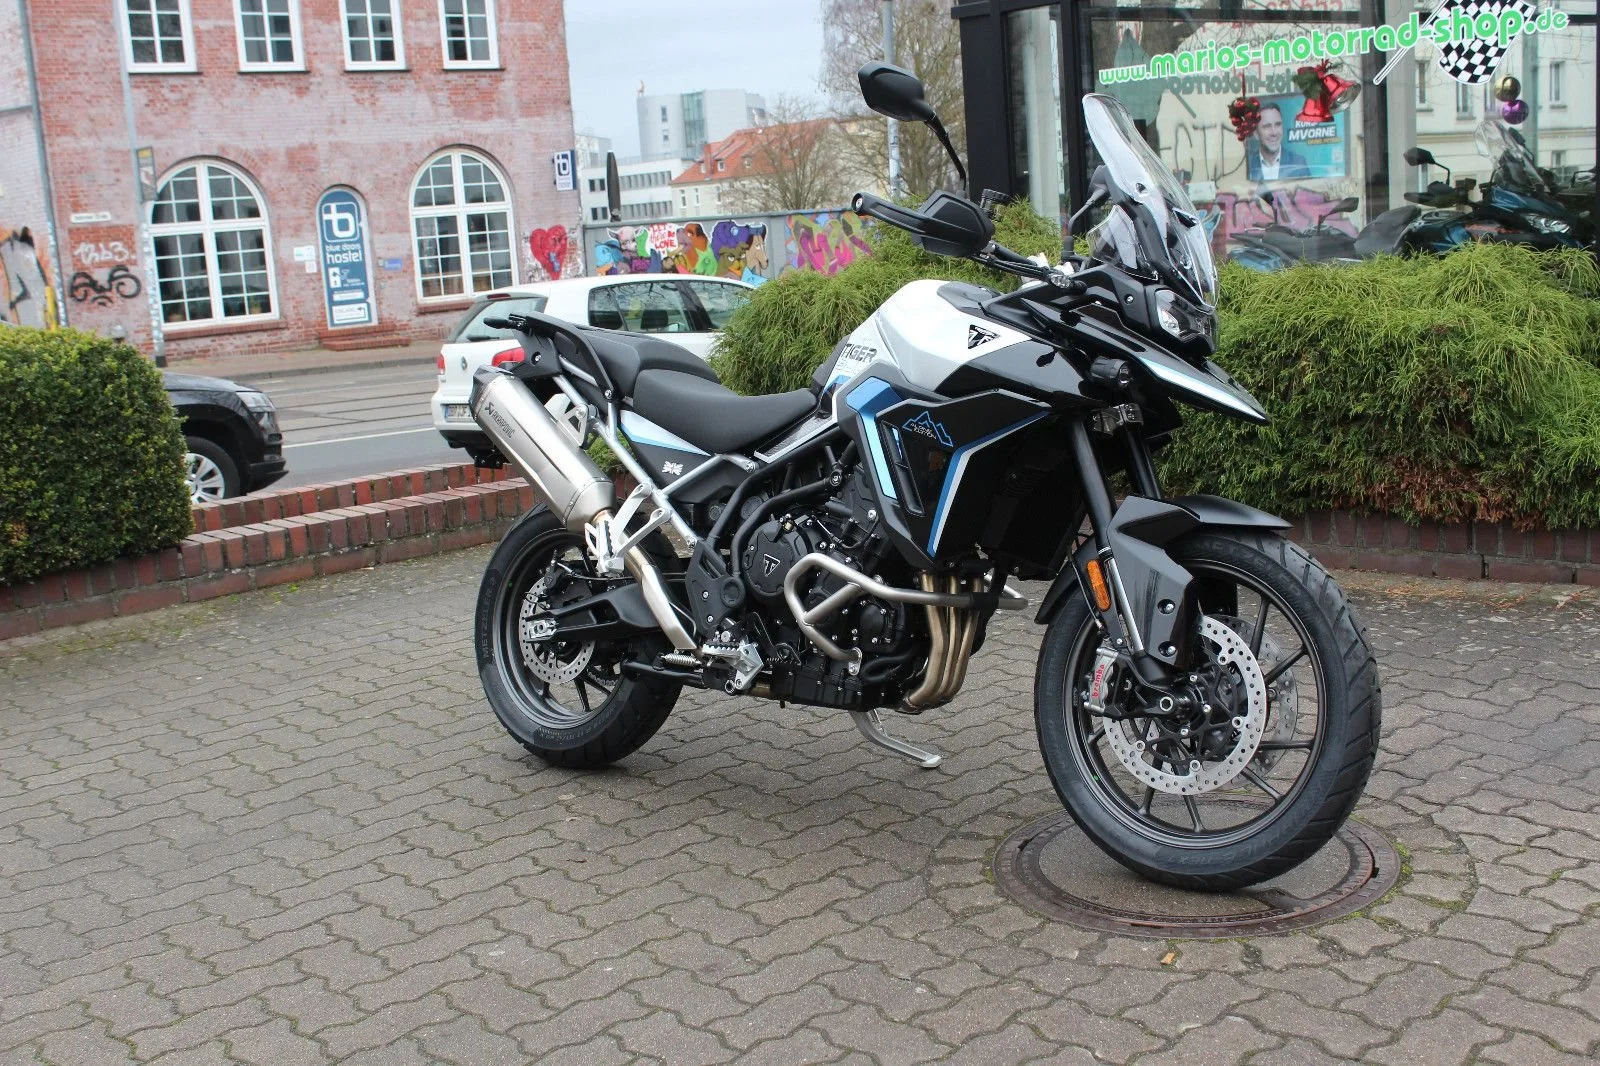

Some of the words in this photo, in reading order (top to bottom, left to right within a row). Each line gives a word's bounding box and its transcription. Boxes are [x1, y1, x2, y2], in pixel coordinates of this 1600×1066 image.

[1098, 7, 1569, 85] www.marios-motorrad-shop.de
[326, 249, 362, 265] hostel
[841, 343, 878, 363] TIGER
